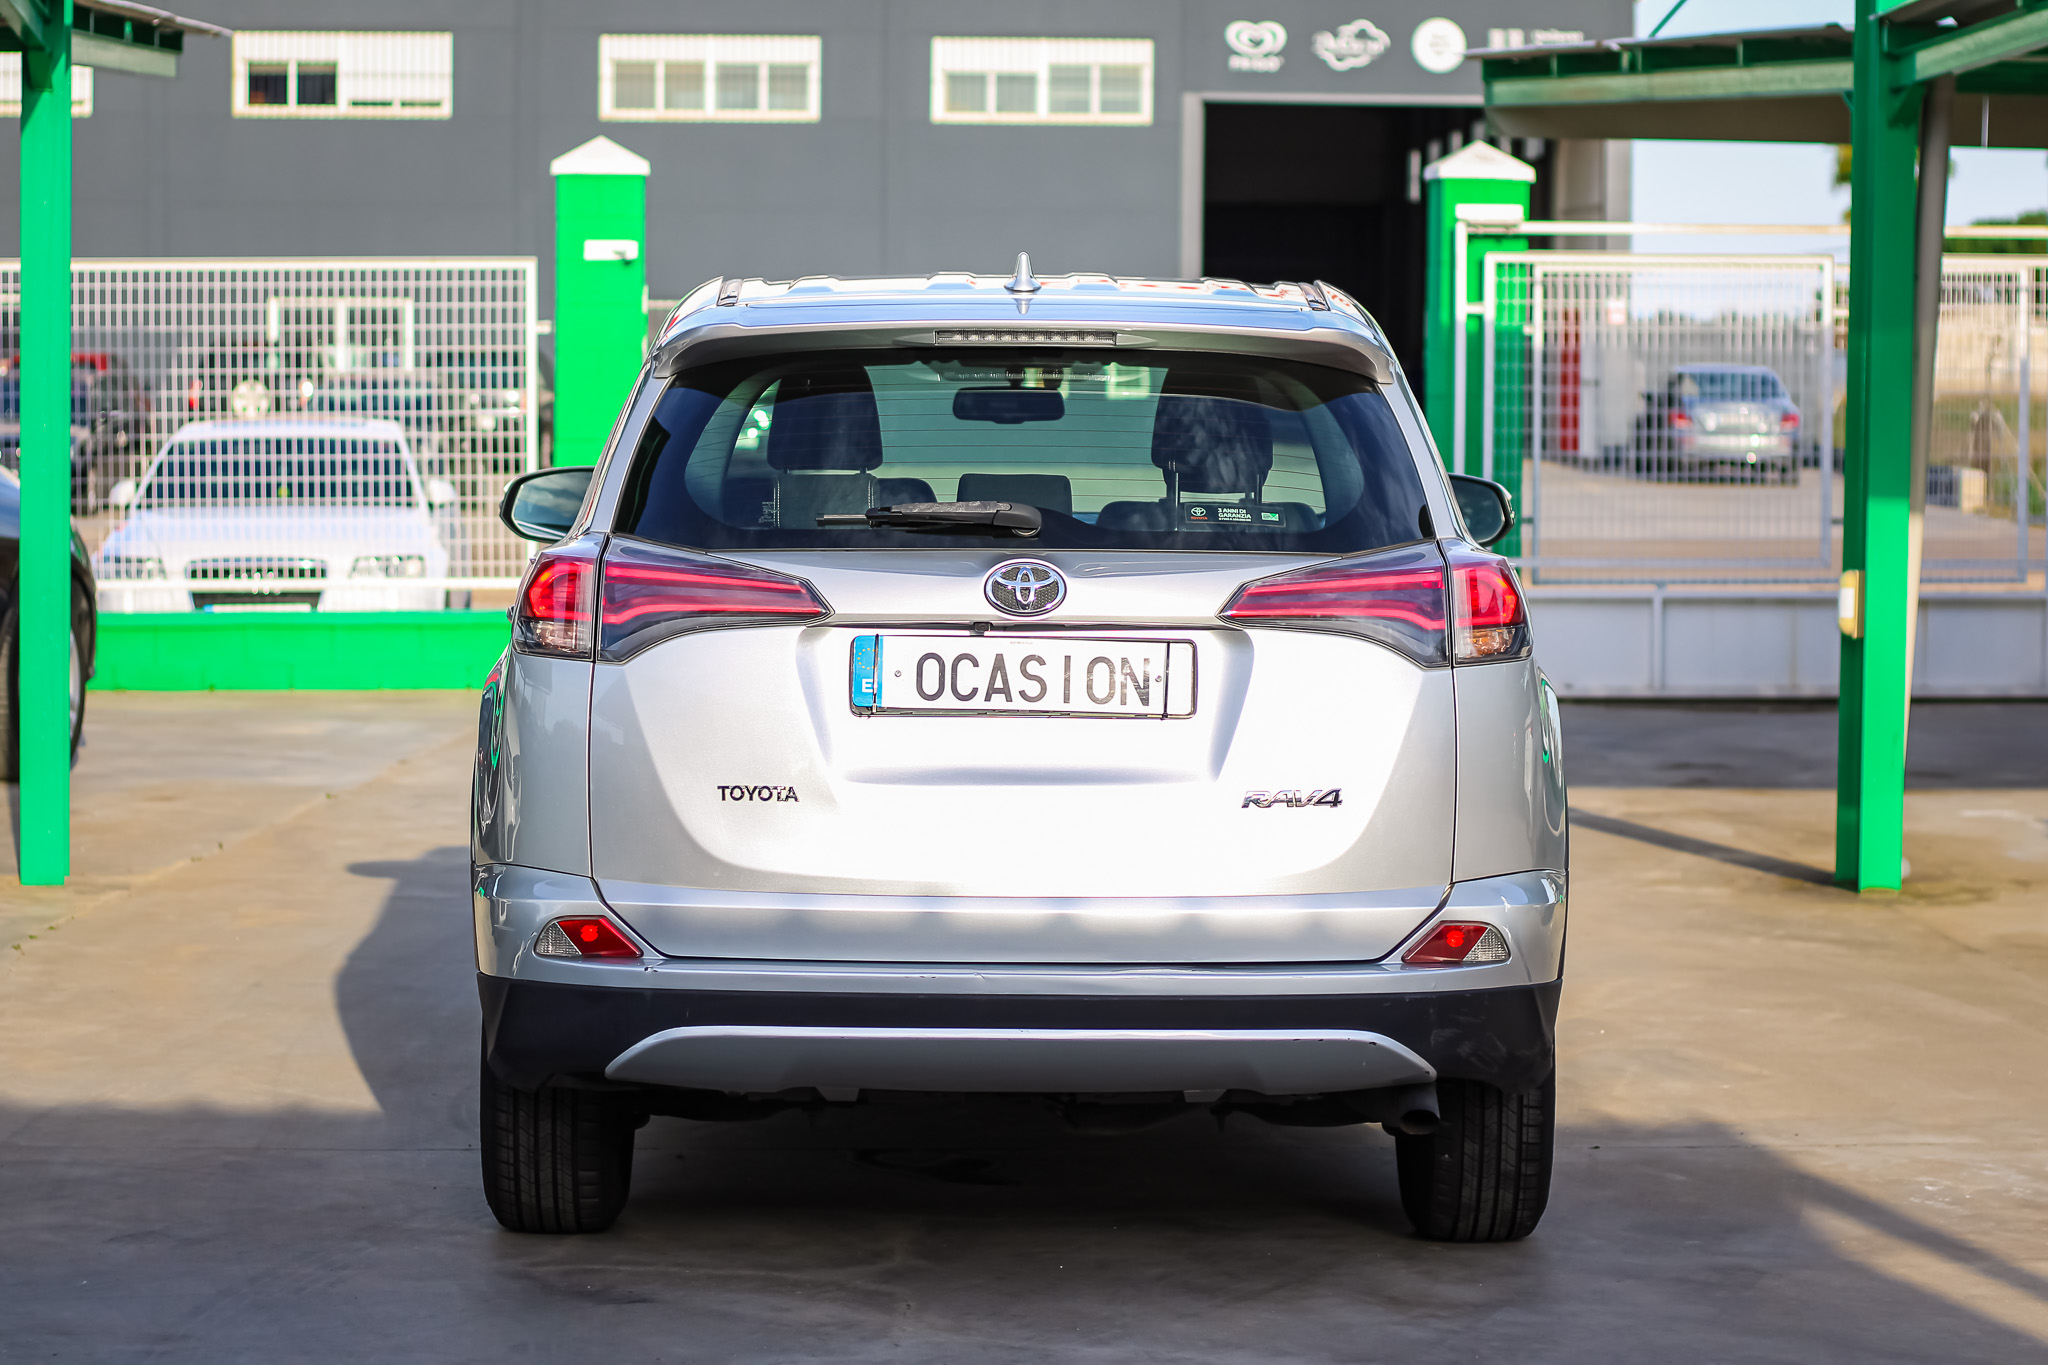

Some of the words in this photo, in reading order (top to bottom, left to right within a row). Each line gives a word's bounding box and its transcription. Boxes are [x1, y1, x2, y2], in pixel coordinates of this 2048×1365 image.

[861, 678, 875, 693] E
[916, 652, 1150, 707] OCASION
[717, 785, 800, 802] TOYOTA
[1241, 788, 1343, 809] RAV4
